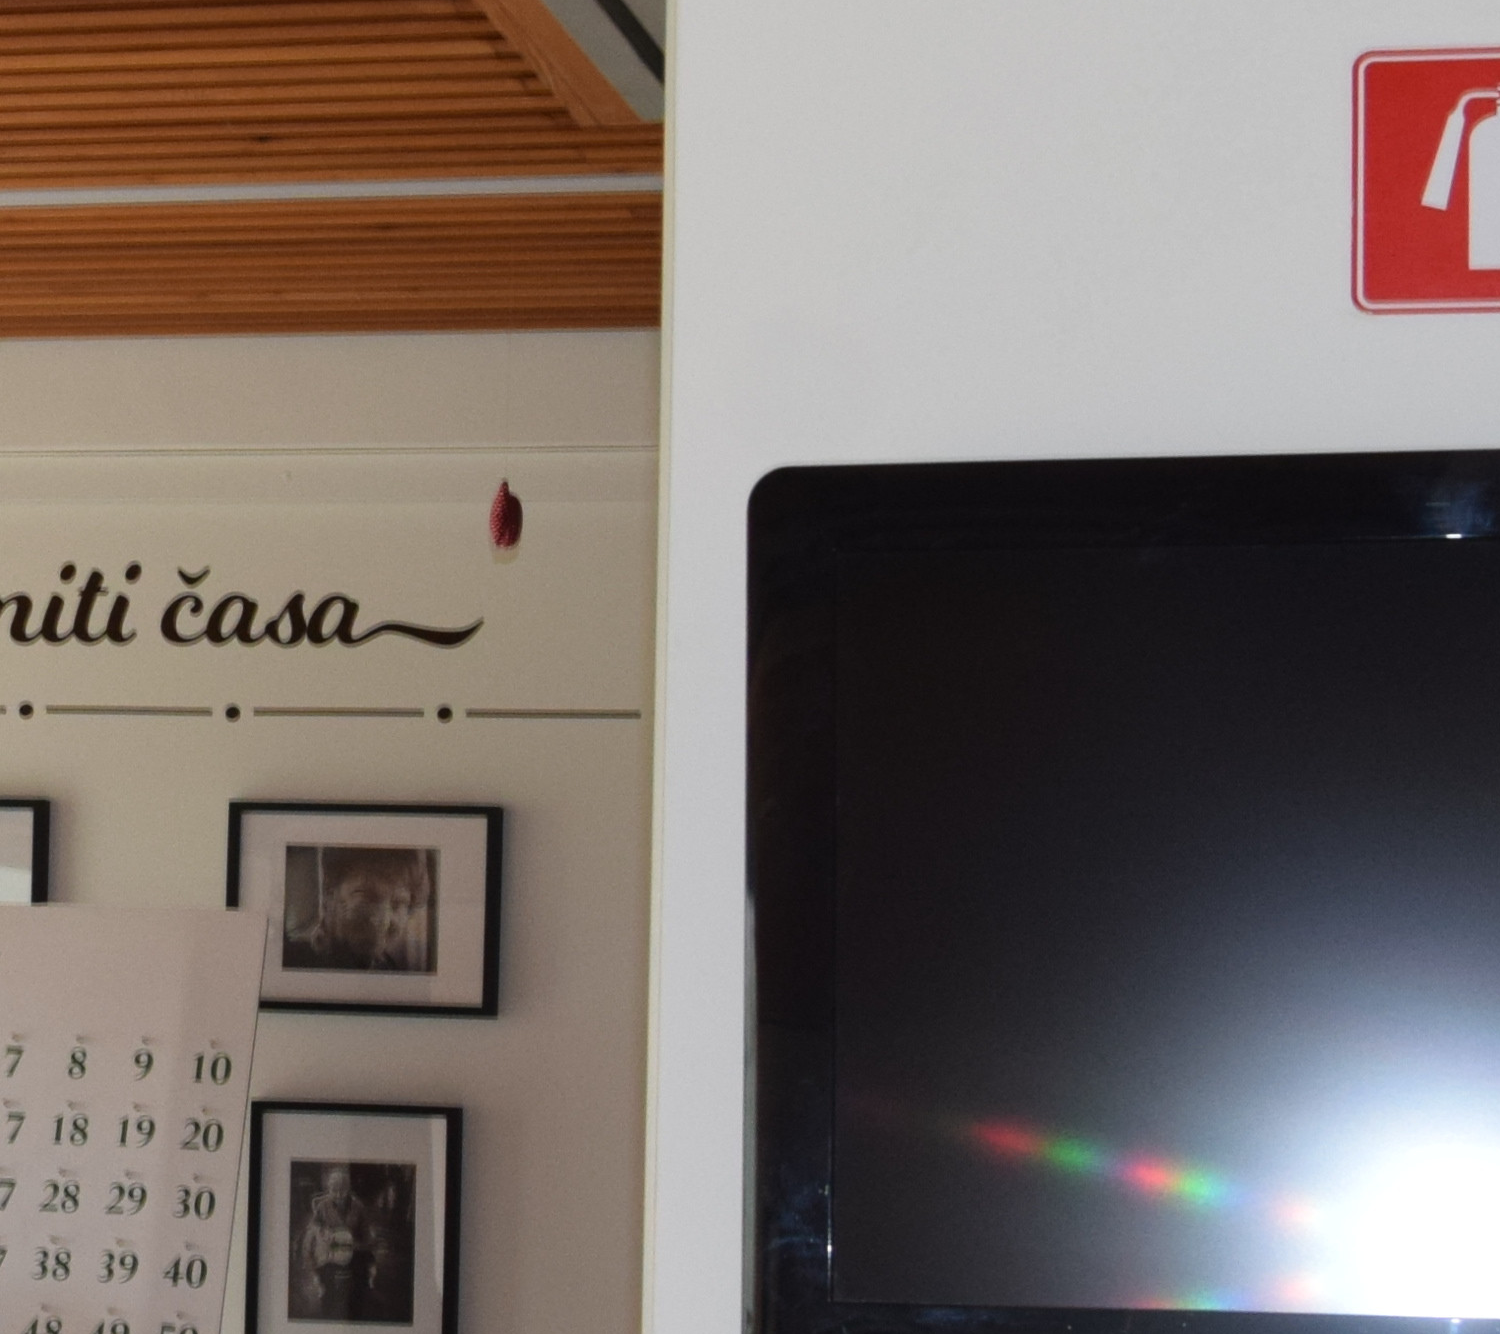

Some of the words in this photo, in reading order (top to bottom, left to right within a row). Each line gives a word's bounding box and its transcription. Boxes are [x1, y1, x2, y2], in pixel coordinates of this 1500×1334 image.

[160, 565, 484, 648] časa
[4, 1043, 26, 1079] 7
[66, 1047, 89, 1080] 8
[132, 1049, 155, 1082] 9
[193, 1052, 234, 1087] 10
[53, 1114, 90, 1147] 18
[118, 1116, 157, 1149] 19
[180, 1117, 225, 1154] 20
[38, 1178, 82, 1214] 28
[105, 1182, 149, 1216] 29
[173, 1185, 217, 1221] 30
[31, 1247, 73, 1282] 38
[95, 1249, 140, 1285] 39
[162, 1255, 209, 1290] 40
